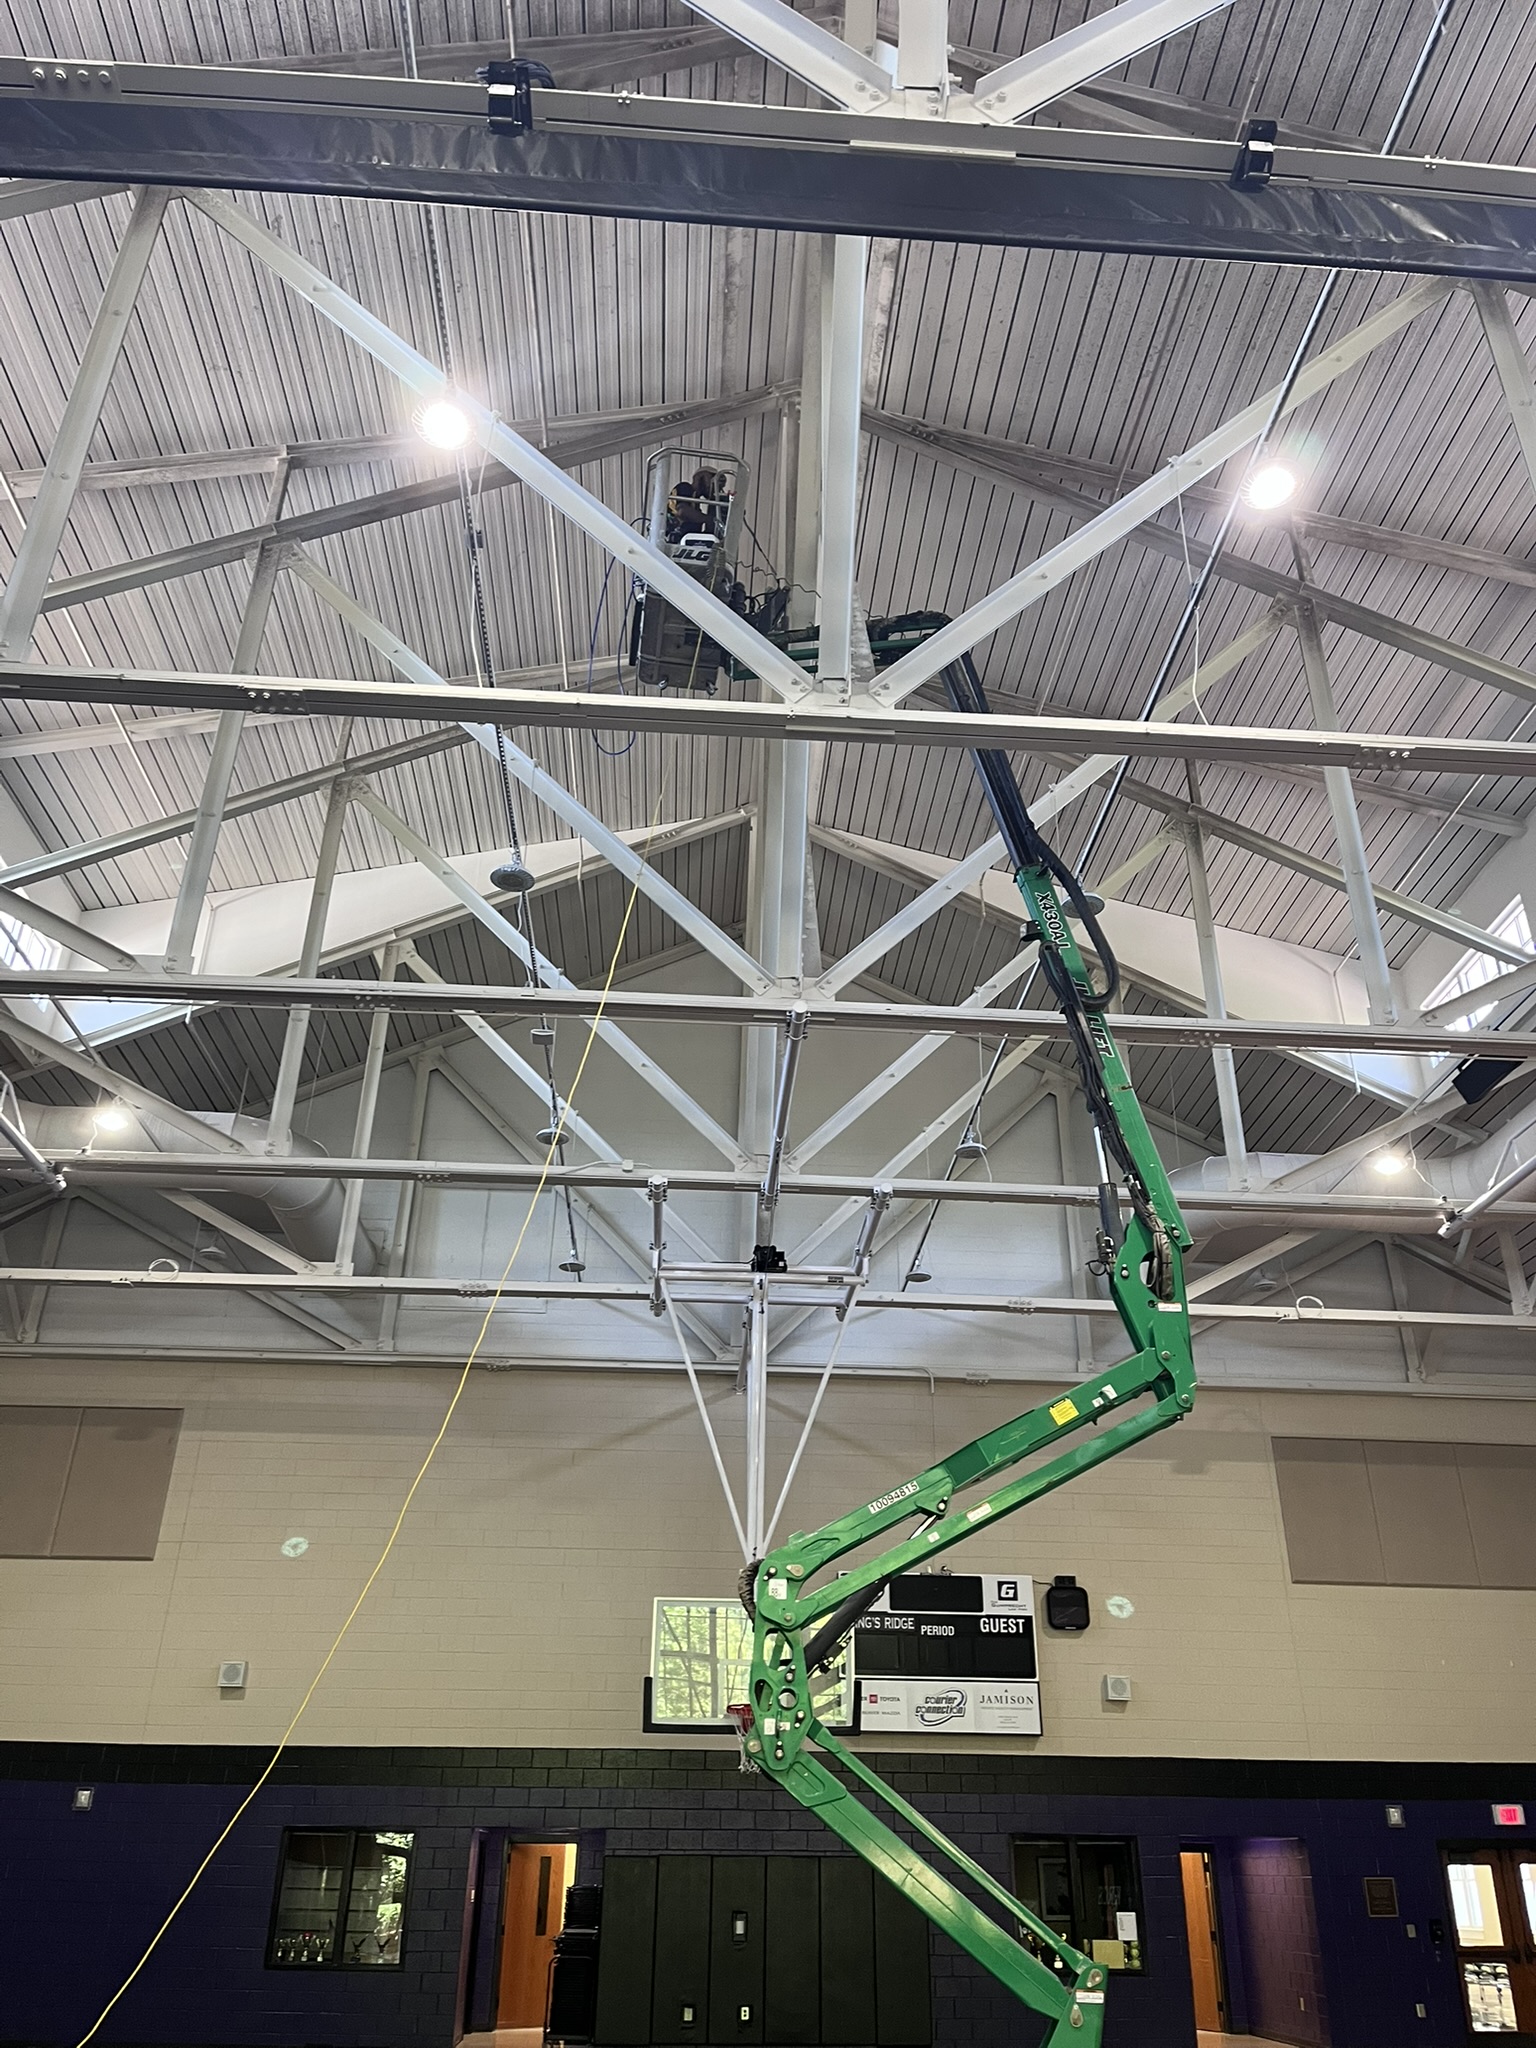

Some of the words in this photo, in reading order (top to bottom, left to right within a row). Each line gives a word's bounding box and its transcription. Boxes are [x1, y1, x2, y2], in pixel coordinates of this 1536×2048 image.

[672, 548, 711, 561] JLG
[870, 1481, 918, 1511] 10094815
[1000, 1584, 1015, 1598] G
[884, 1617, 915, 1630] RIDGE
[980, 1617, 1025, 1633] GUEST
[921, 1625, 955, 1636] PERIOD
[979, 1695, 1034, 1705] JAMISON
